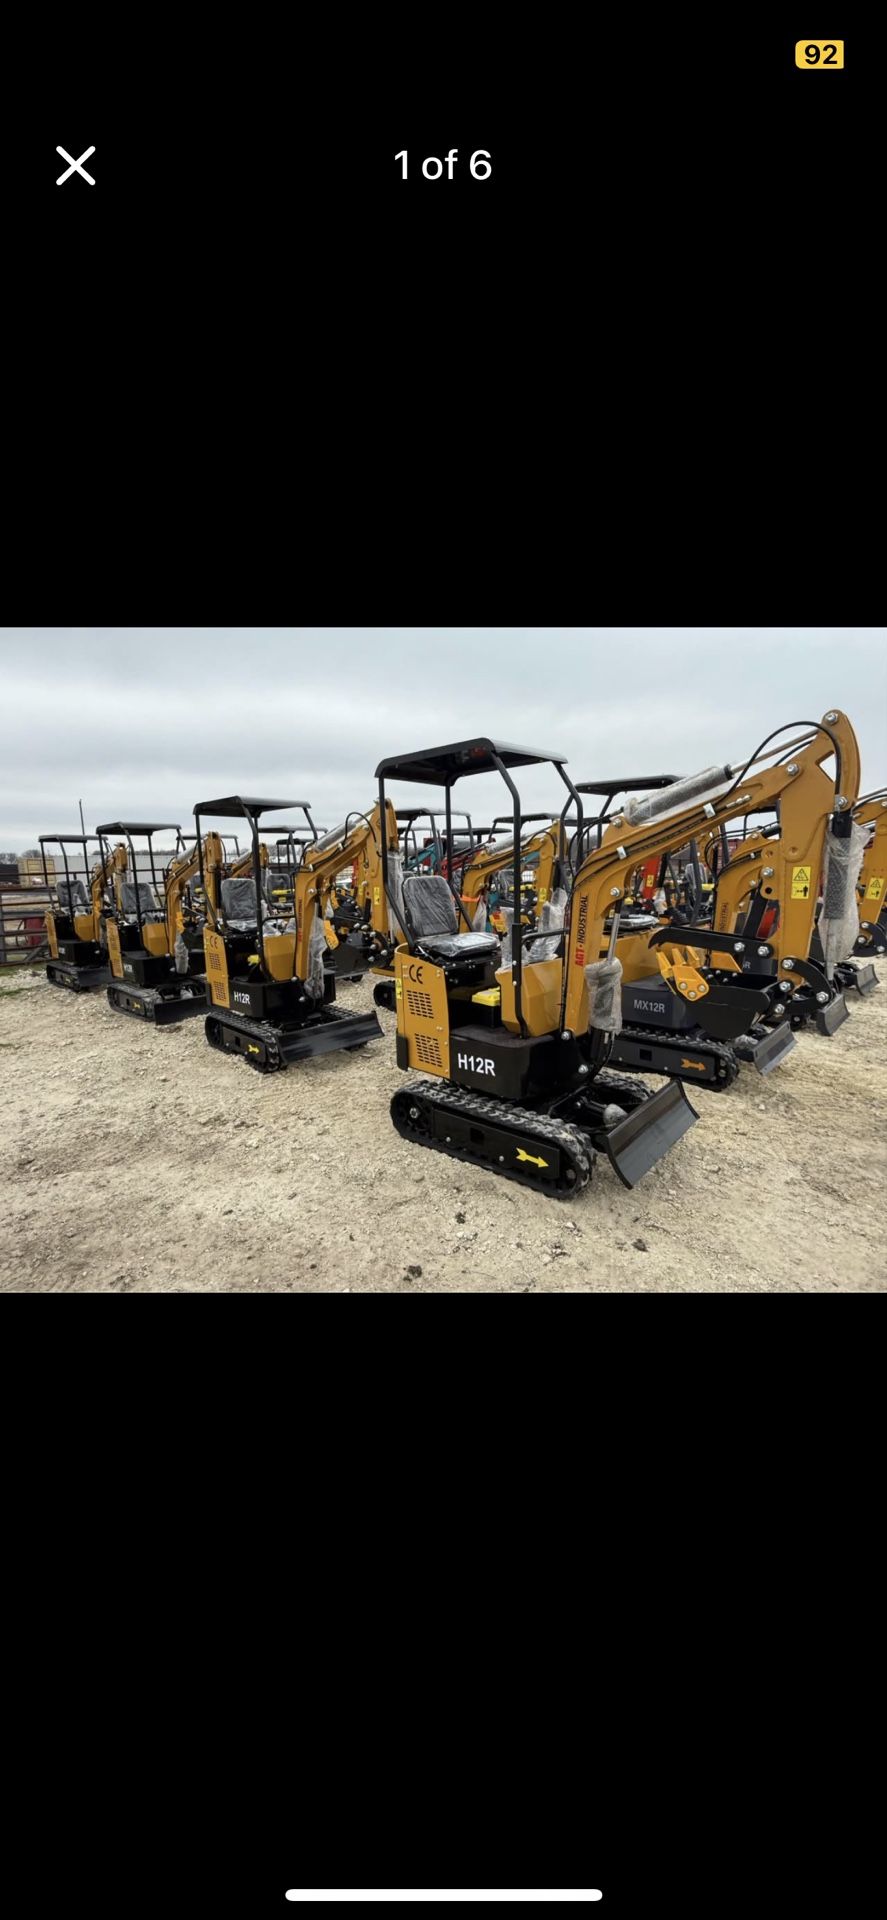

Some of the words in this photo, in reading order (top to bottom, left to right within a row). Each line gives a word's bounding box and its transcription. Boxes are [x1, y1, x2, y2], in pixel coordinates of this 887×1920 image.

[577, 895, 588, 944] INDUSTRIAL
[409, 964, 424, 984] CE
[233, 991, 251, 1004] H12R
[633, 999, 665, 1013] MX12R
[457, 1052, 496, 1077] H12R
